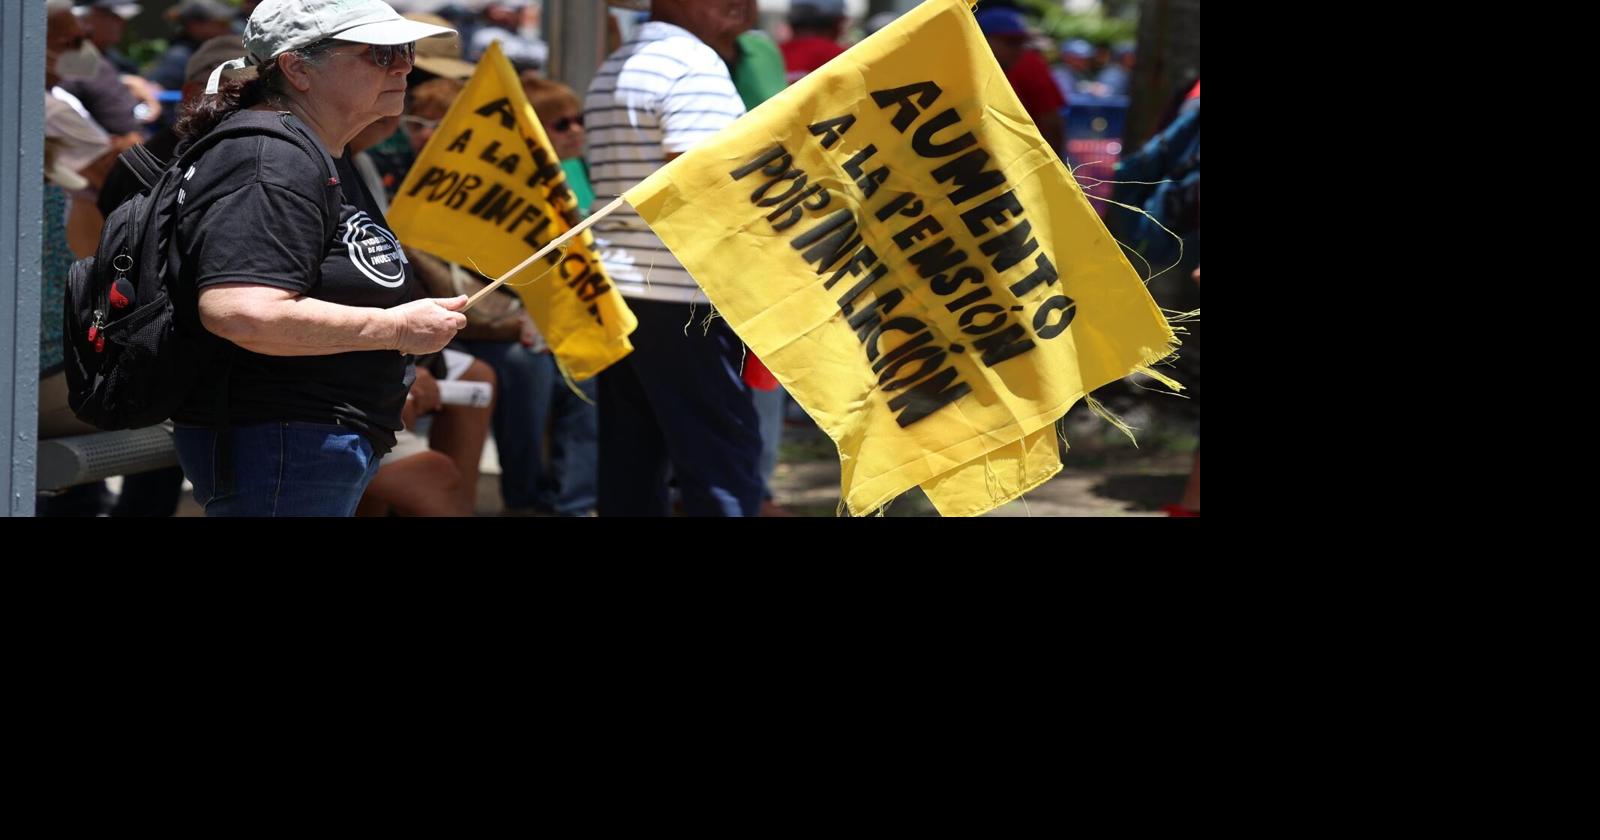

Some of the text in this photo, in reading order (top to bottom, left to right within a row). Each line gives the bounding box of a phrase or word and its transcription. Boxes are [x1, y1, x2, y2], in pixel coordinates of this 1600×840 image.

[406, 166, 482, 210] POR
[446, 128, 520, 175] A LA
[807, 113, 1037, 368] A LA PENSIÓN
[870, 80, 1076, 340] AUMENTO
[729, 142, 973, 429] POR INFLACIÓN
